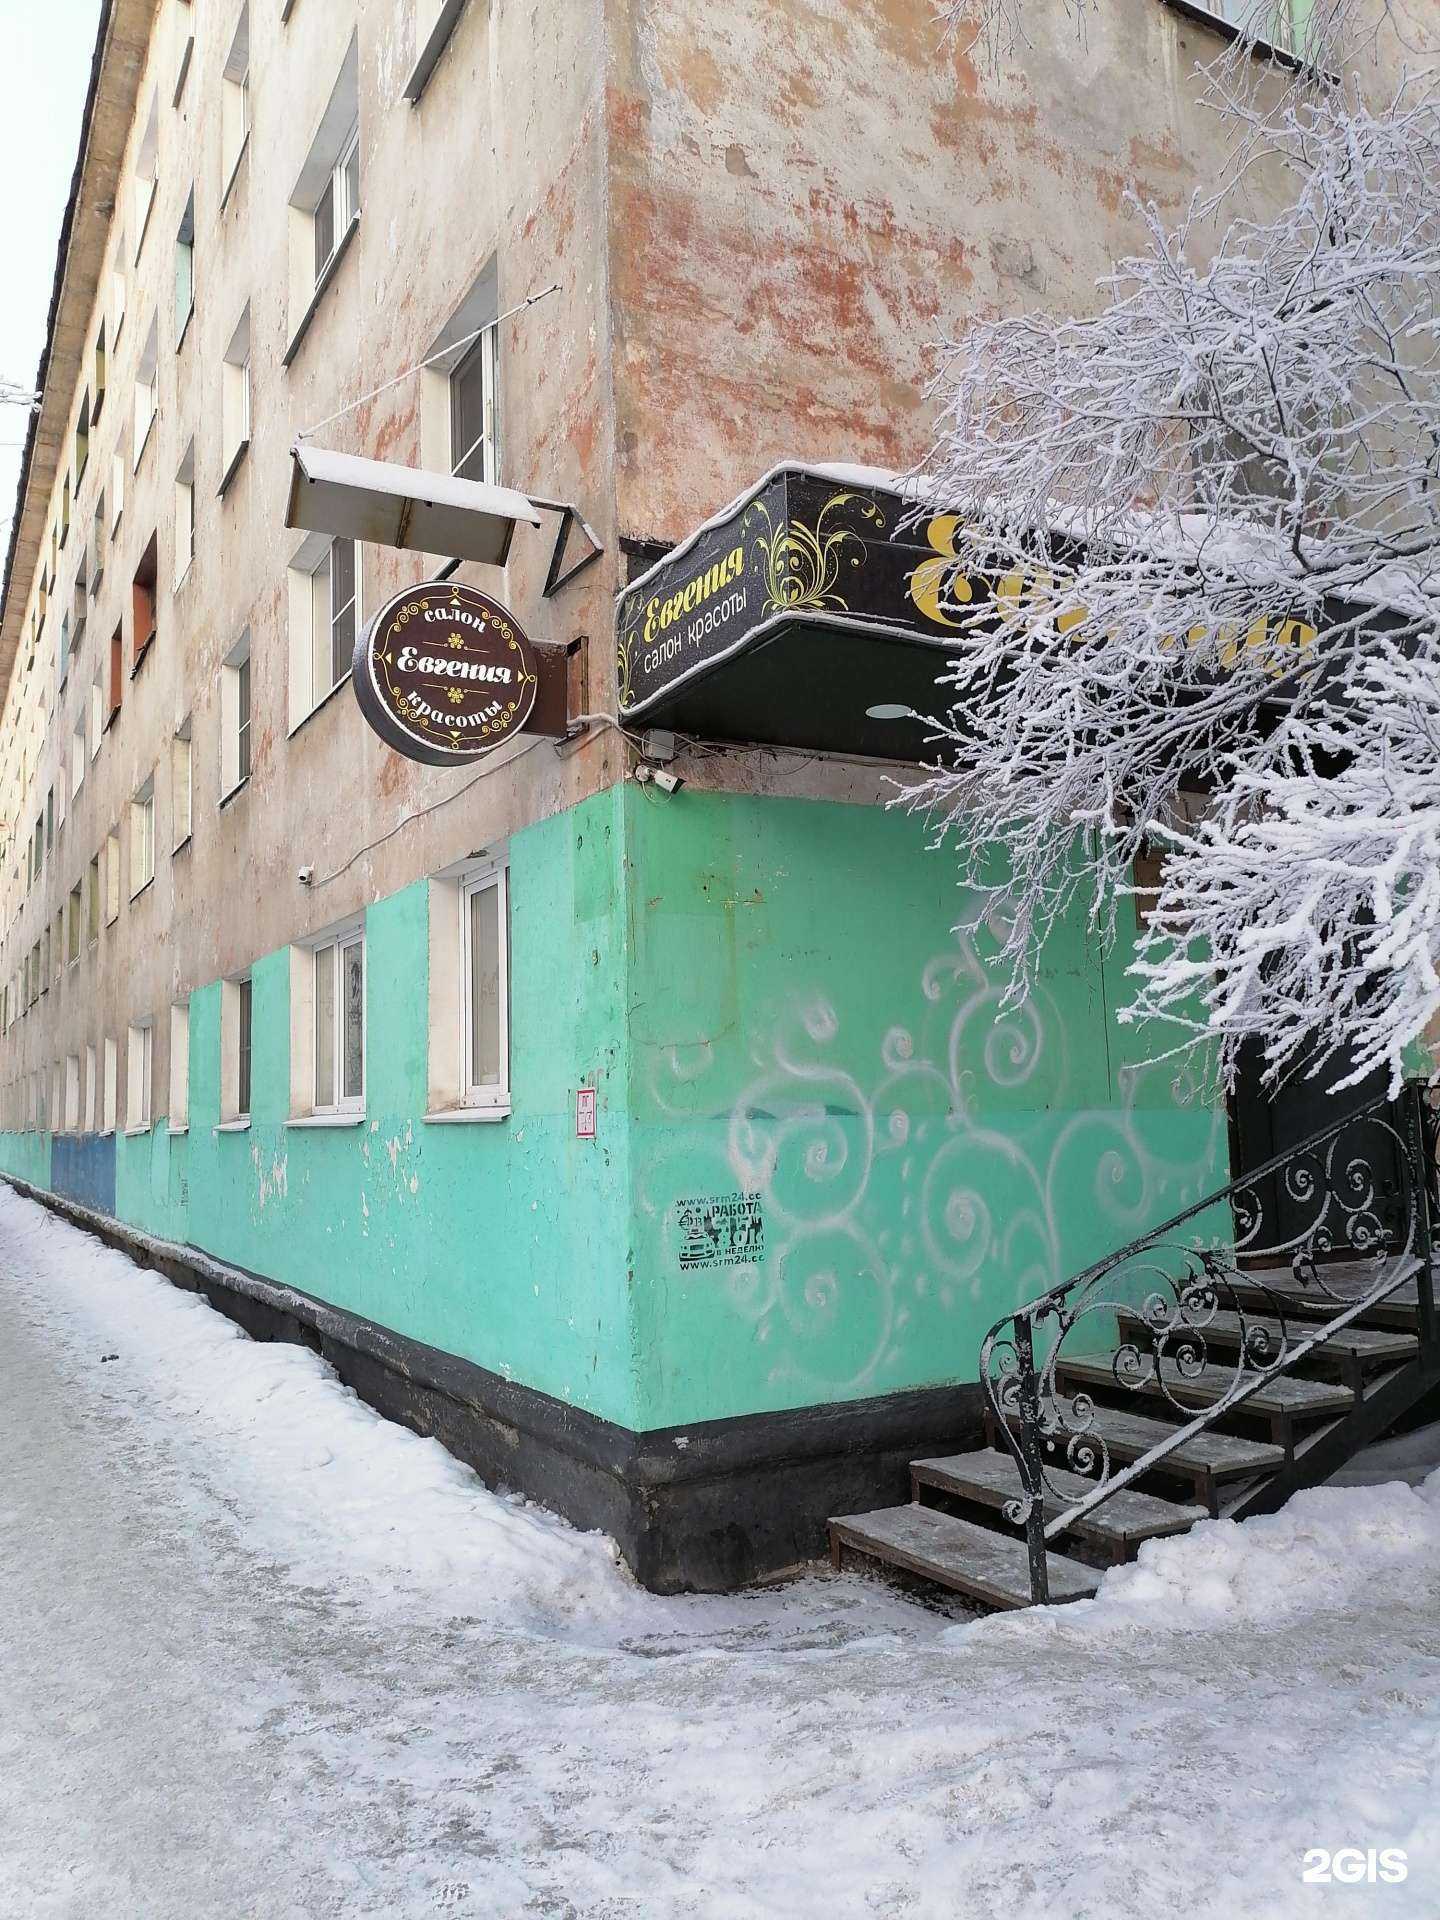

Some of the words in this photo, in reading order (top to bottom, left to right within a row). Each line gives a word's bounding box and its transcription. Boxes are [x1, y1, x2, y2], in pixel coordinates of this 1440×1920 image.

[643, 546, 746, 644] Евгения
[423, 607, 487, 633] салон
[644, 632, 683, 674] салон
[687, 588, 748, 648] красоты
[396, 646, 513, 684] Евгения
[406, 690, 503, 728] красоты
[676, 1192, 762, 1207] www.srm24.cc
[712, 1202, 763, 1218] РАБОТА
[680, 1254, 765, 1271] www.srm24.cc
